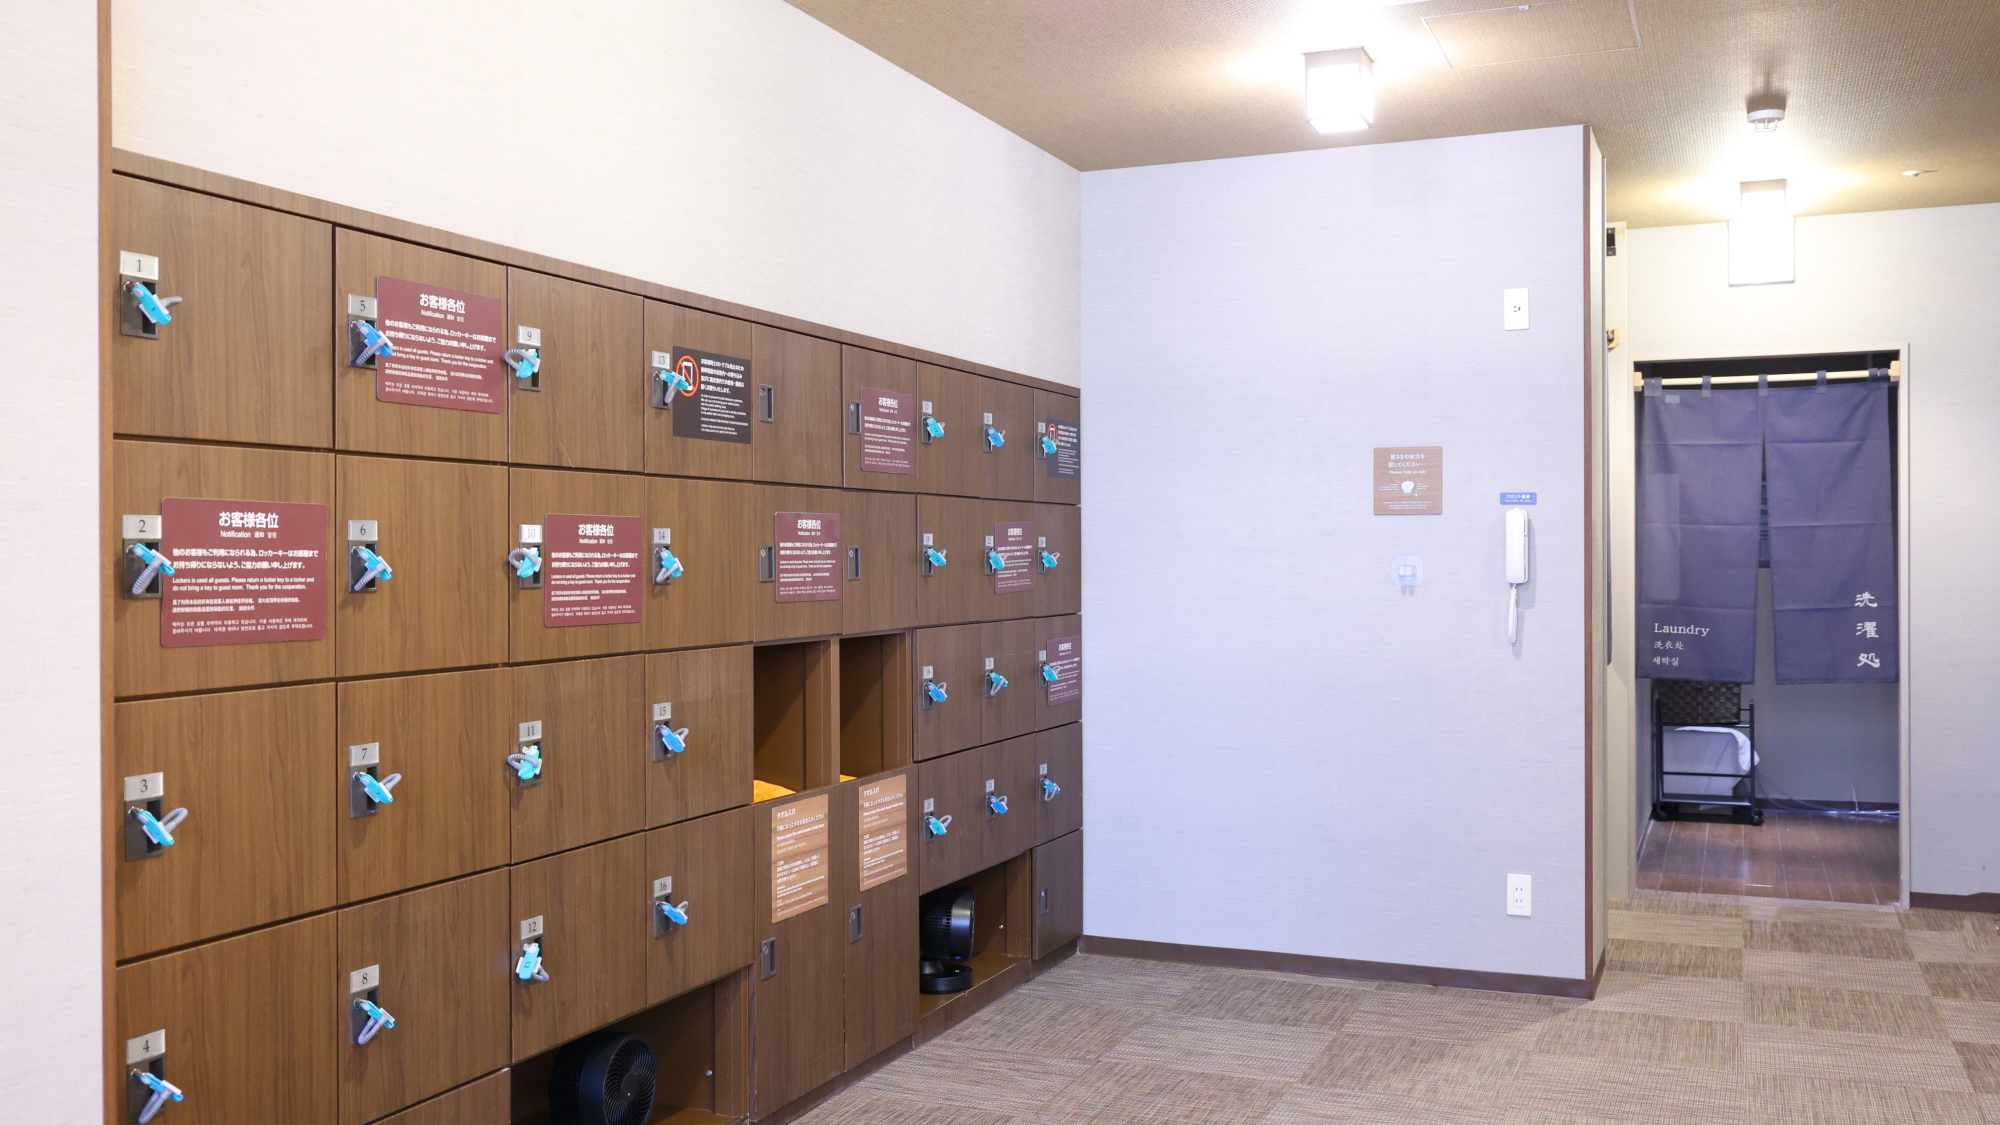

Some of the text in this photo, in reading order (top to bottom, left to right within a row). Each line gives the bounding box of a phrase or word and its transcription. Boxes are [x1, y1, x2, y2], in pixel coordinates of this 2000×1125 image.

[136, 259, 142, 272] 1
[360, 300, 366, 311] 5
[419, 294, 466, 314] お客様各位
[420, 309, 445, 319] Notification
[527, 331, 532, 341] 9
[658, 356, 665, 365] 13
[219, 511, 279, 528] お客様各位
[139, 519, 146, 532] 2
[360, 524, 366, 535] 6
[578, 524, 614, 536] お客様各位
[220, 530, 251, 538] Notification
[527, 528, 536, 538] 10
[658, 531, 666, 540] 14
[1653, 622, 1710, 637] Laundry
[1652, 656, 1679, 667] 세탁실
[659, 707, 666, 716] 15
[527, 726, 535, 736] 11
[362, 748, 368, 759] 7
[140, 779, 148, 793] 3
[660, 882, 667, 891] 16
[528, 922, 537, 933] 12
[362, 973, 368, 984] 8
[142, 1039, 150, 1052] 4
